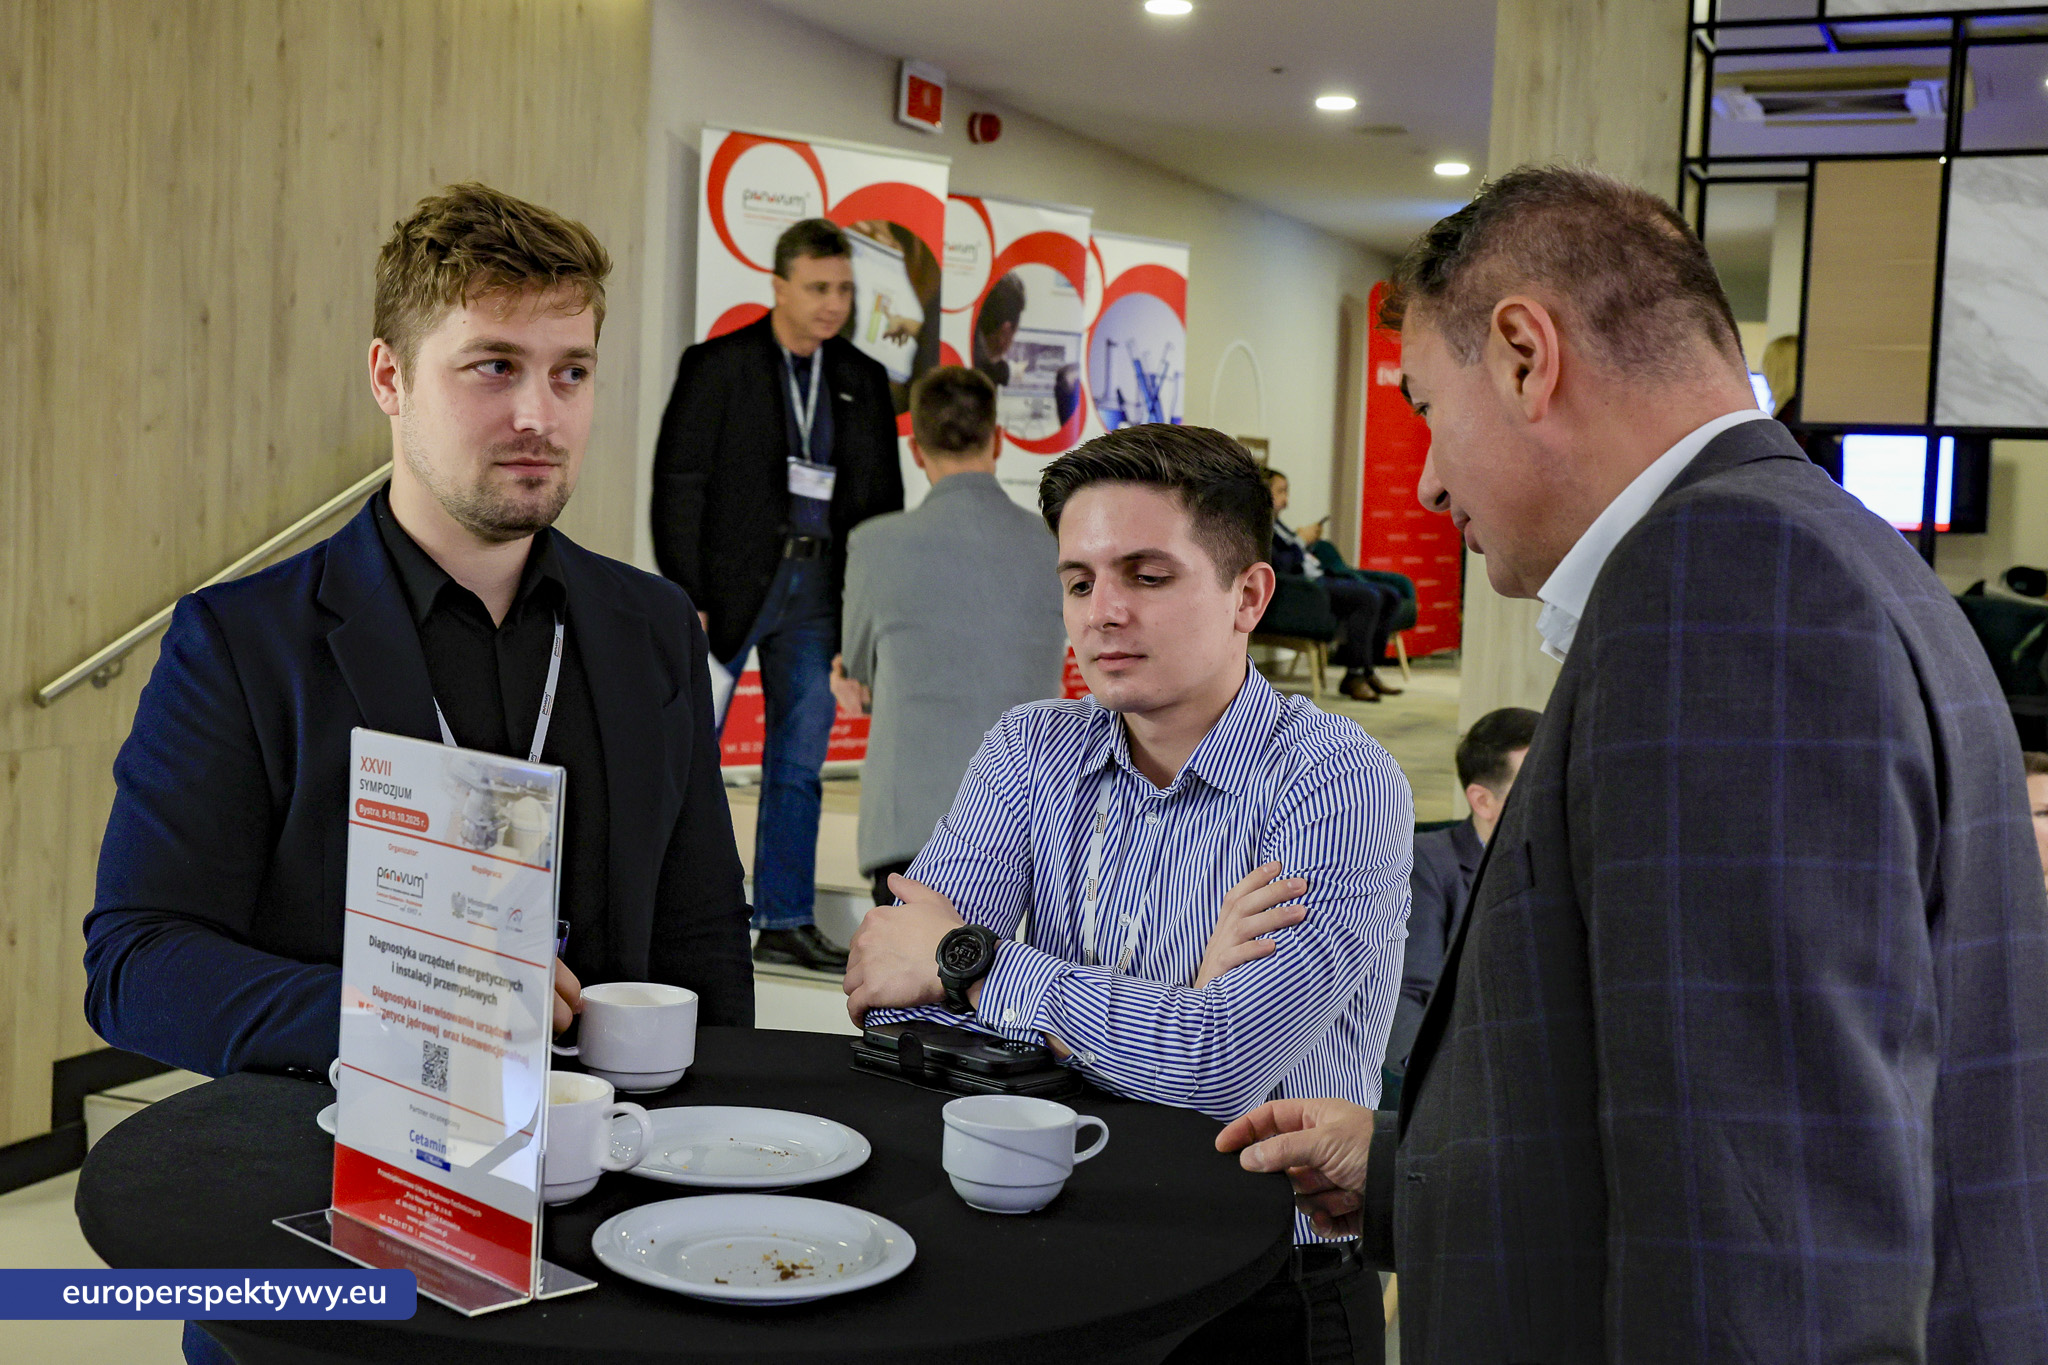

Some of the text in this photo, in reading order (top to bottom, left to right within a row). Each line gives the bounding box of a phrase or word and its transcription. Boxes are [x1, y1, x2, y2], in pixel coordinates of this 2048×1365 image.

[360, 756, 392, 776] XXVII
[359, 778, 412, 800] SYMPOZJUM
[359, 803, 381, 818] Bystra,
[369, 935, 524, 993] Diagnostyka urządzeń energetycznych
[396, 962, 432, 987] instalacji
[372, 985, 417, 1009] Diagnostyka
[422, 1004, 475, 1029] serwisowanie
[406, 1014, 440, 1038] jądrowej
[409, 1129, 447, 1155] Cetamin
